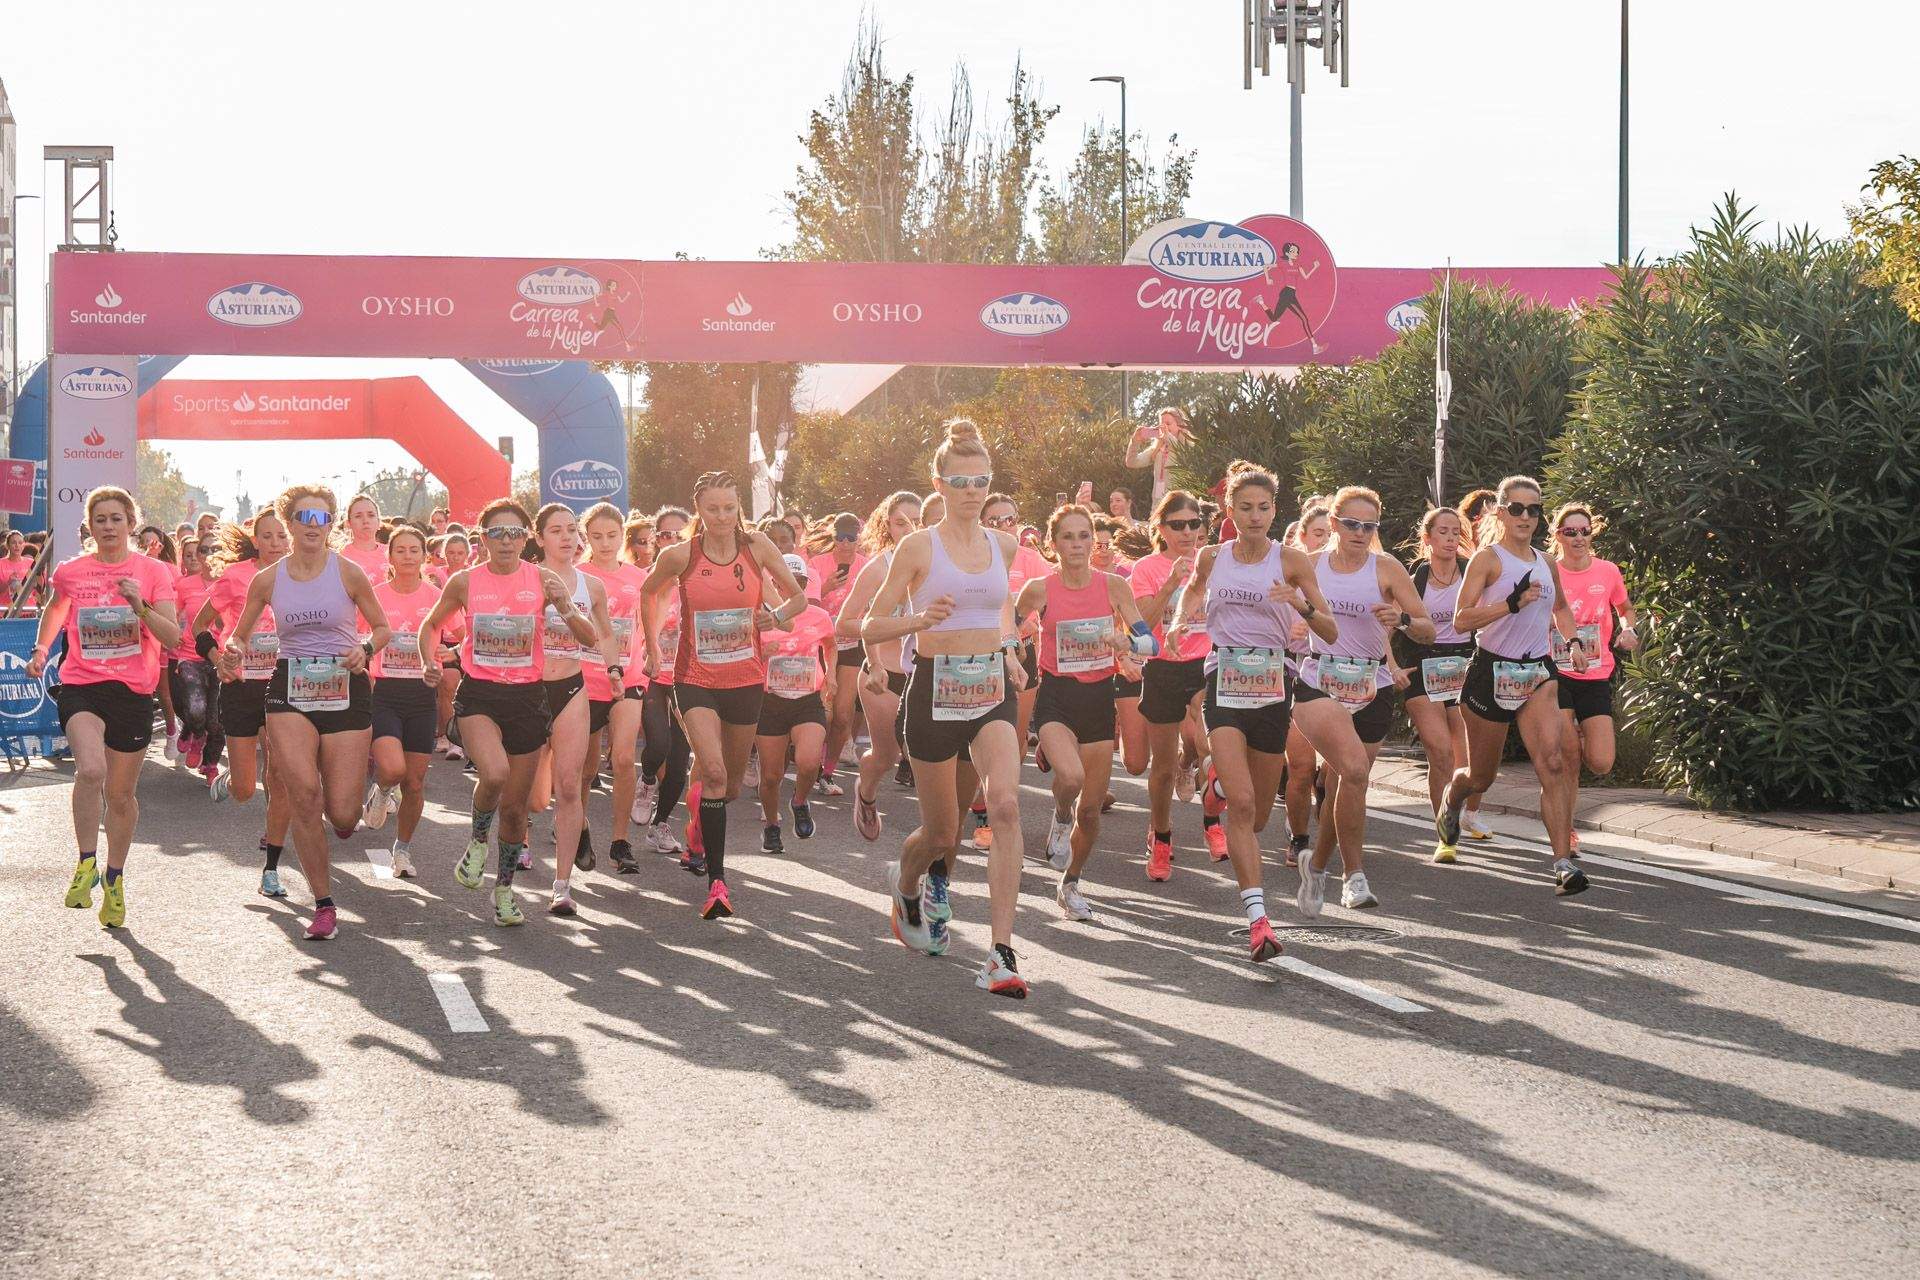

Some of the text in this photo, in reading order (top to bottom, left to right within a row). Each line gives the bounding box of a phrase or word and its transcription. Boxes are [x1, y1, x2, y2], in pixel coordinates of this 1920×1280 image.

[1159, 243, 1265, 266] ASTURIANA
[524, 279, 595, 295] ASTURIANA
[1136, 277, 1242, 310] Carrera
[215, 298, 295, 315] ASTURIANA
[362, 296, 455, 316] OYSHO
[510, 301, 579, 323] Carrera
[833, 302, 922, 323] OYSHO
[70, 310, 147, 324] Santander
[988, 307, 1062, 324] ASTURIANA
[702, 317, 776, 332] Santander
[527, 322, 605, 355] de la Mujer
[1163, 307, 1281, 359] de la Mujer
[66, 378, 127, 391] ASTURIANA
[174, 395, 351, 415] Sports Santander
[63, 448, 124, 460] Santander
[554, 475, 619, 490] ASTURIANA
[1219, 588, 1263, 602] OYSHO
[285, 610, 328, 623] OYSHO
[1240, 675, 1264, 685] 016
[959, 684, 985, 695] 016
